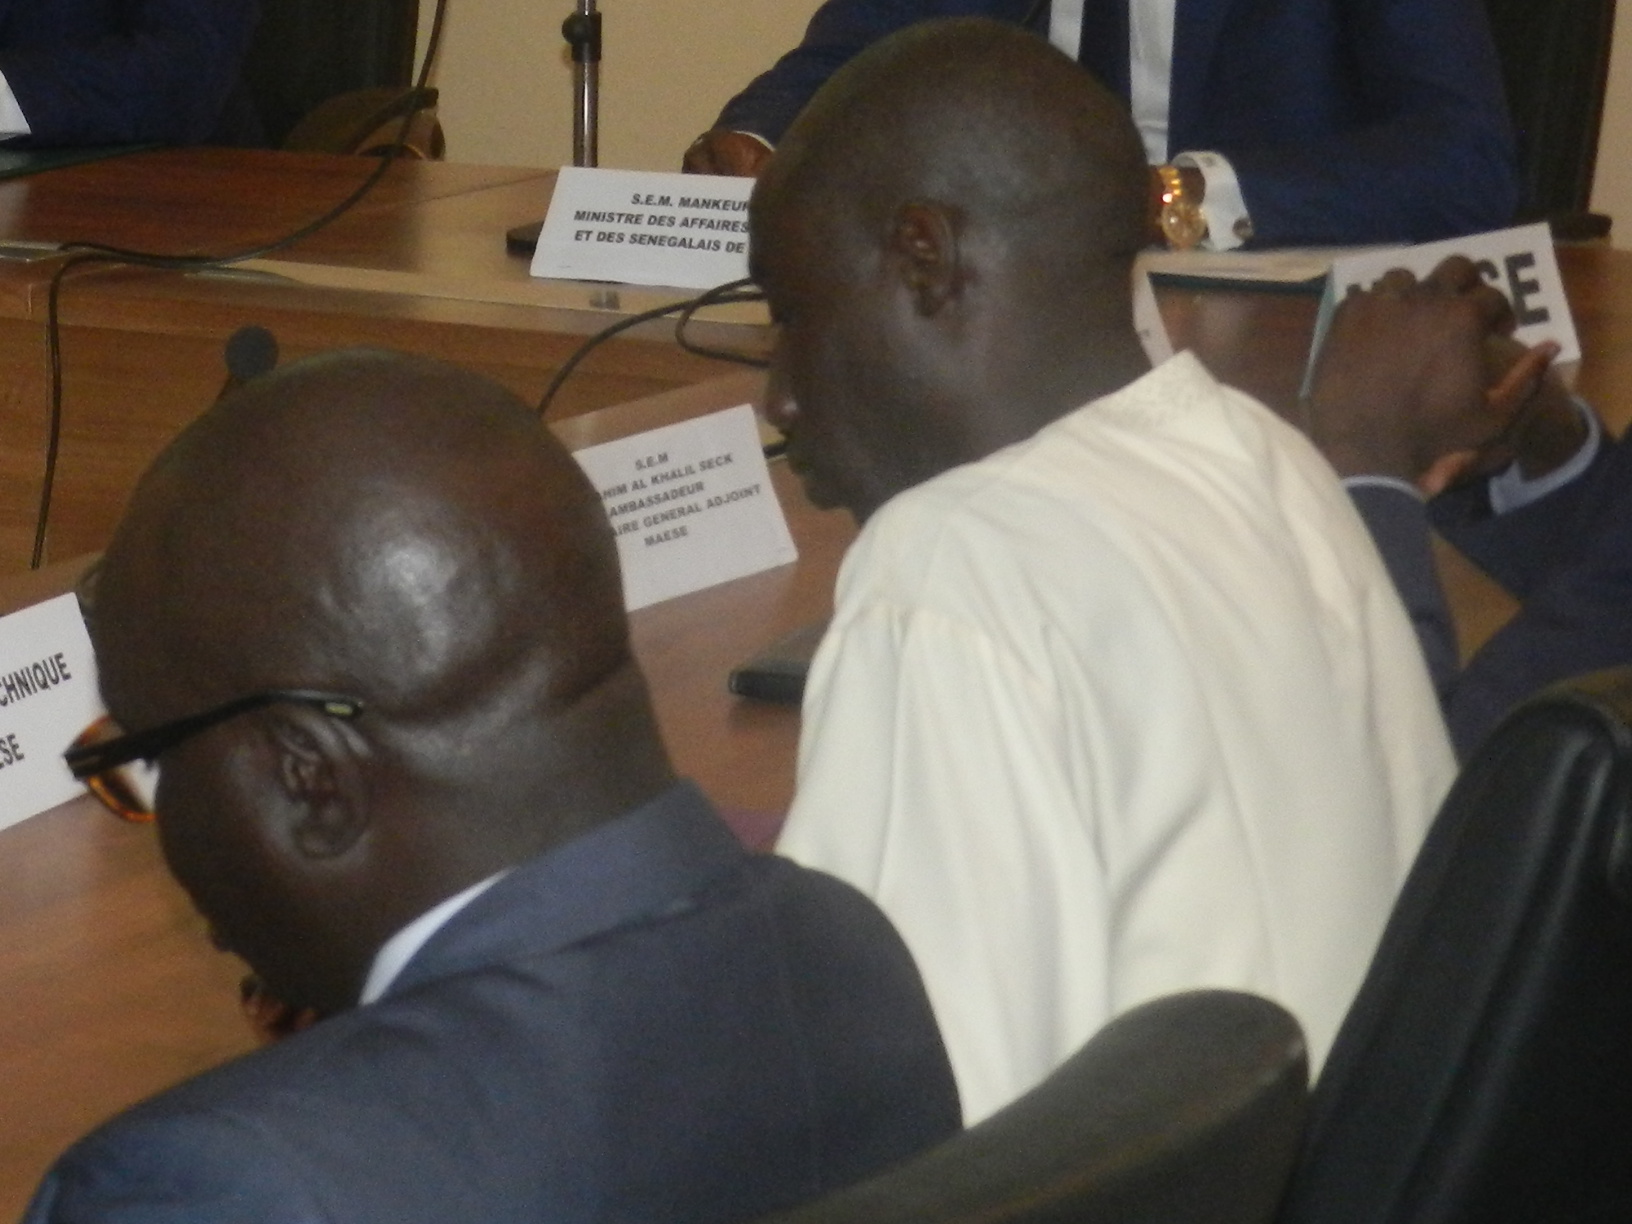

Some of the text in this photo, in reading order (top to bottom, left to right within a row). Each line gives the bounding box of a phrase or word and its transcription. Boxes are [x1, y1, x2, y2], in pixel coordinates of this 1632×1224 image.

[631, 193, 673, 207] S.E.M.
[574, 210, 749, 233] MINISTRE DES AFFAIRES
[574, 230, 745, 254] ET DES SENEGALAIS DE
[699, 453, 733, 472] SECK
[610, 481, 704, 516] AMBASSADEUR
[643, 502, 702, 527] GENERAL
[707, 483, 761, 510] ADJOINT
